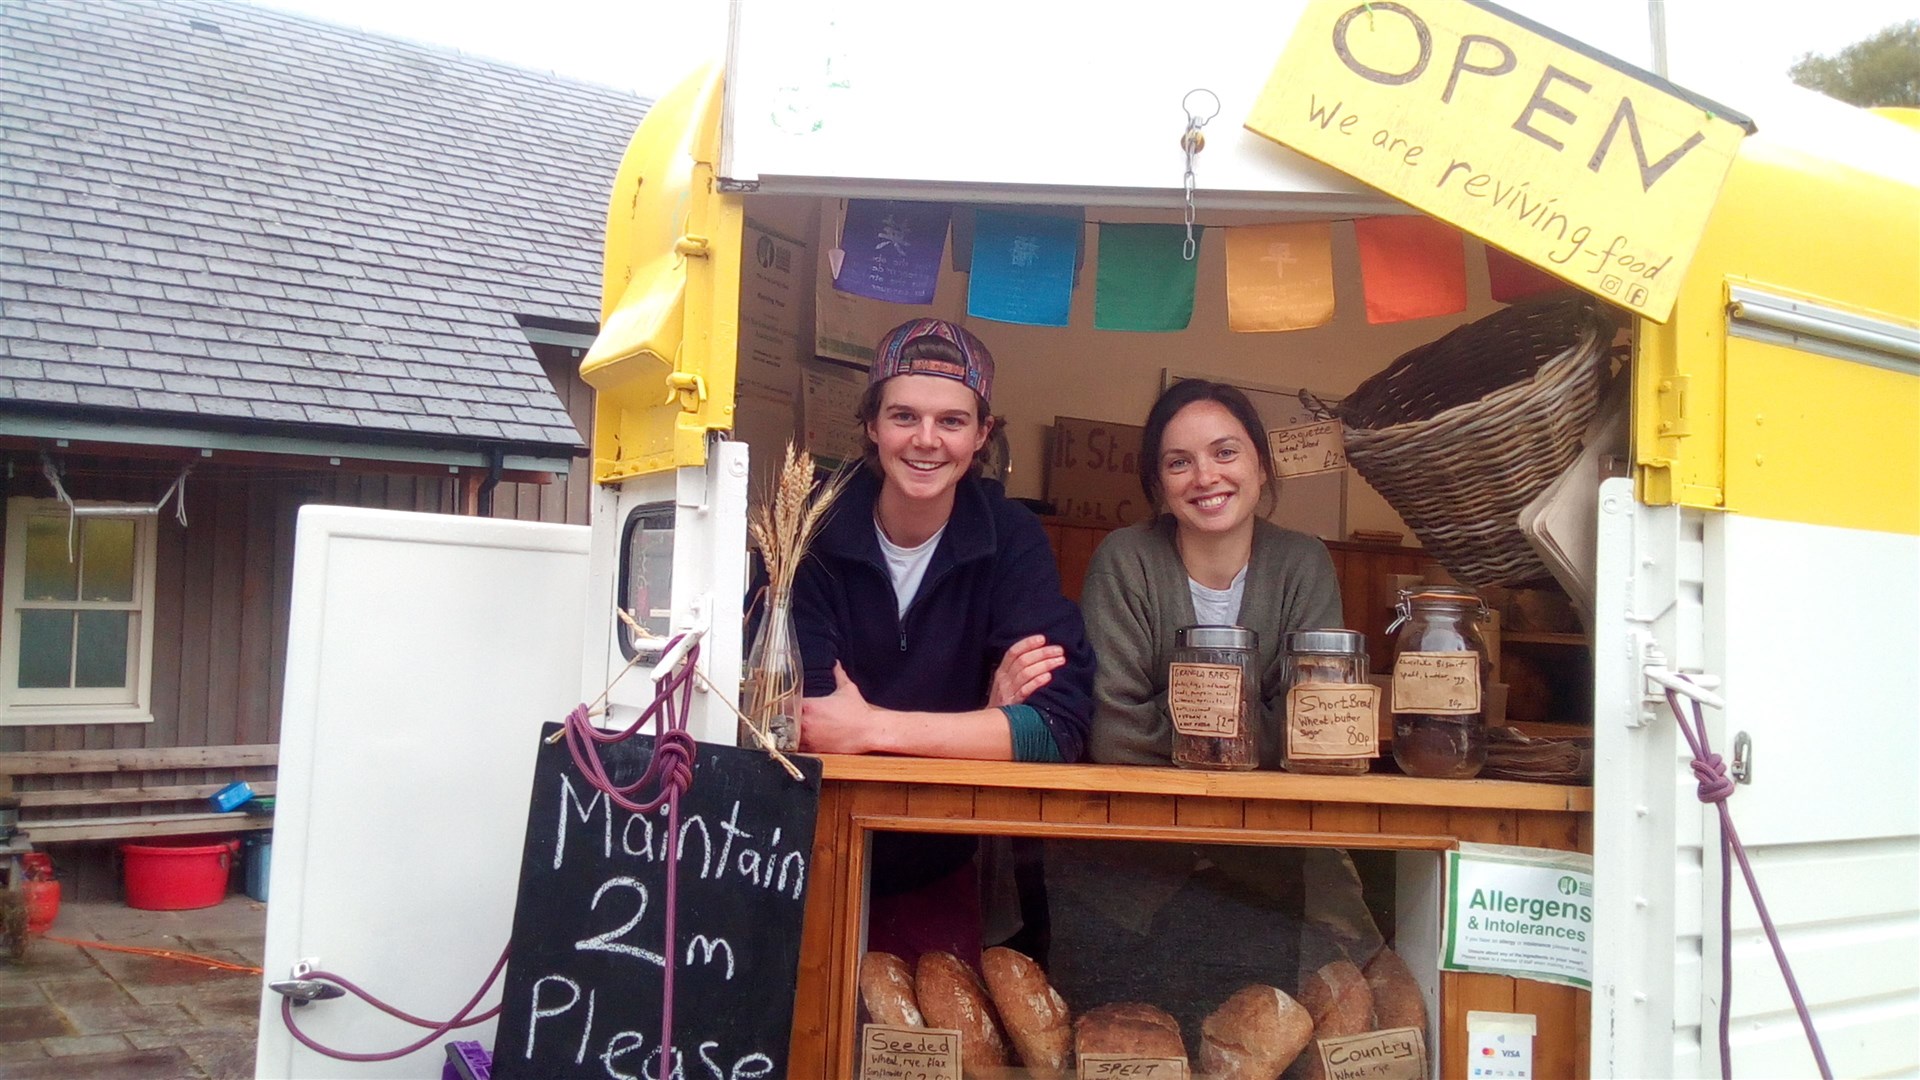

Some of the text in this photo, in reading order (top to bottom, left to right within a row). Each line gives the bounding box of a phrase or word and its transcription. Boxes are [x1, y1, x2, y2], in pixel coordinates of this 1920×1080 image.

[1332, 0, 1706, 193] OPEN
[1309, 94, 1359, 136] We
[1372, 130, 1424, 167] are
[1279, 426, 1333, 443] Baguette
[1209, 671, 1230, 680] BARS
[1449, 699, 1462, 708] 80p
[1334, 713, 1360, 722] butter
[1300, 726, 1369, 746] sugar 80p
[553, 773, 805, 900] Maintain
[1469, 888, 1592, 922] Allergens
[1468, 916, 1586, 942] & Intolerances
[525, 975, 774, 1080] Please
[871, 1033, 949, 1053] Seeded
[1329, 1040, 1413, 1064] Country
[927, 1058, 946, 1067] flax
[1097, 1063, 1159, 1076] SPELT
